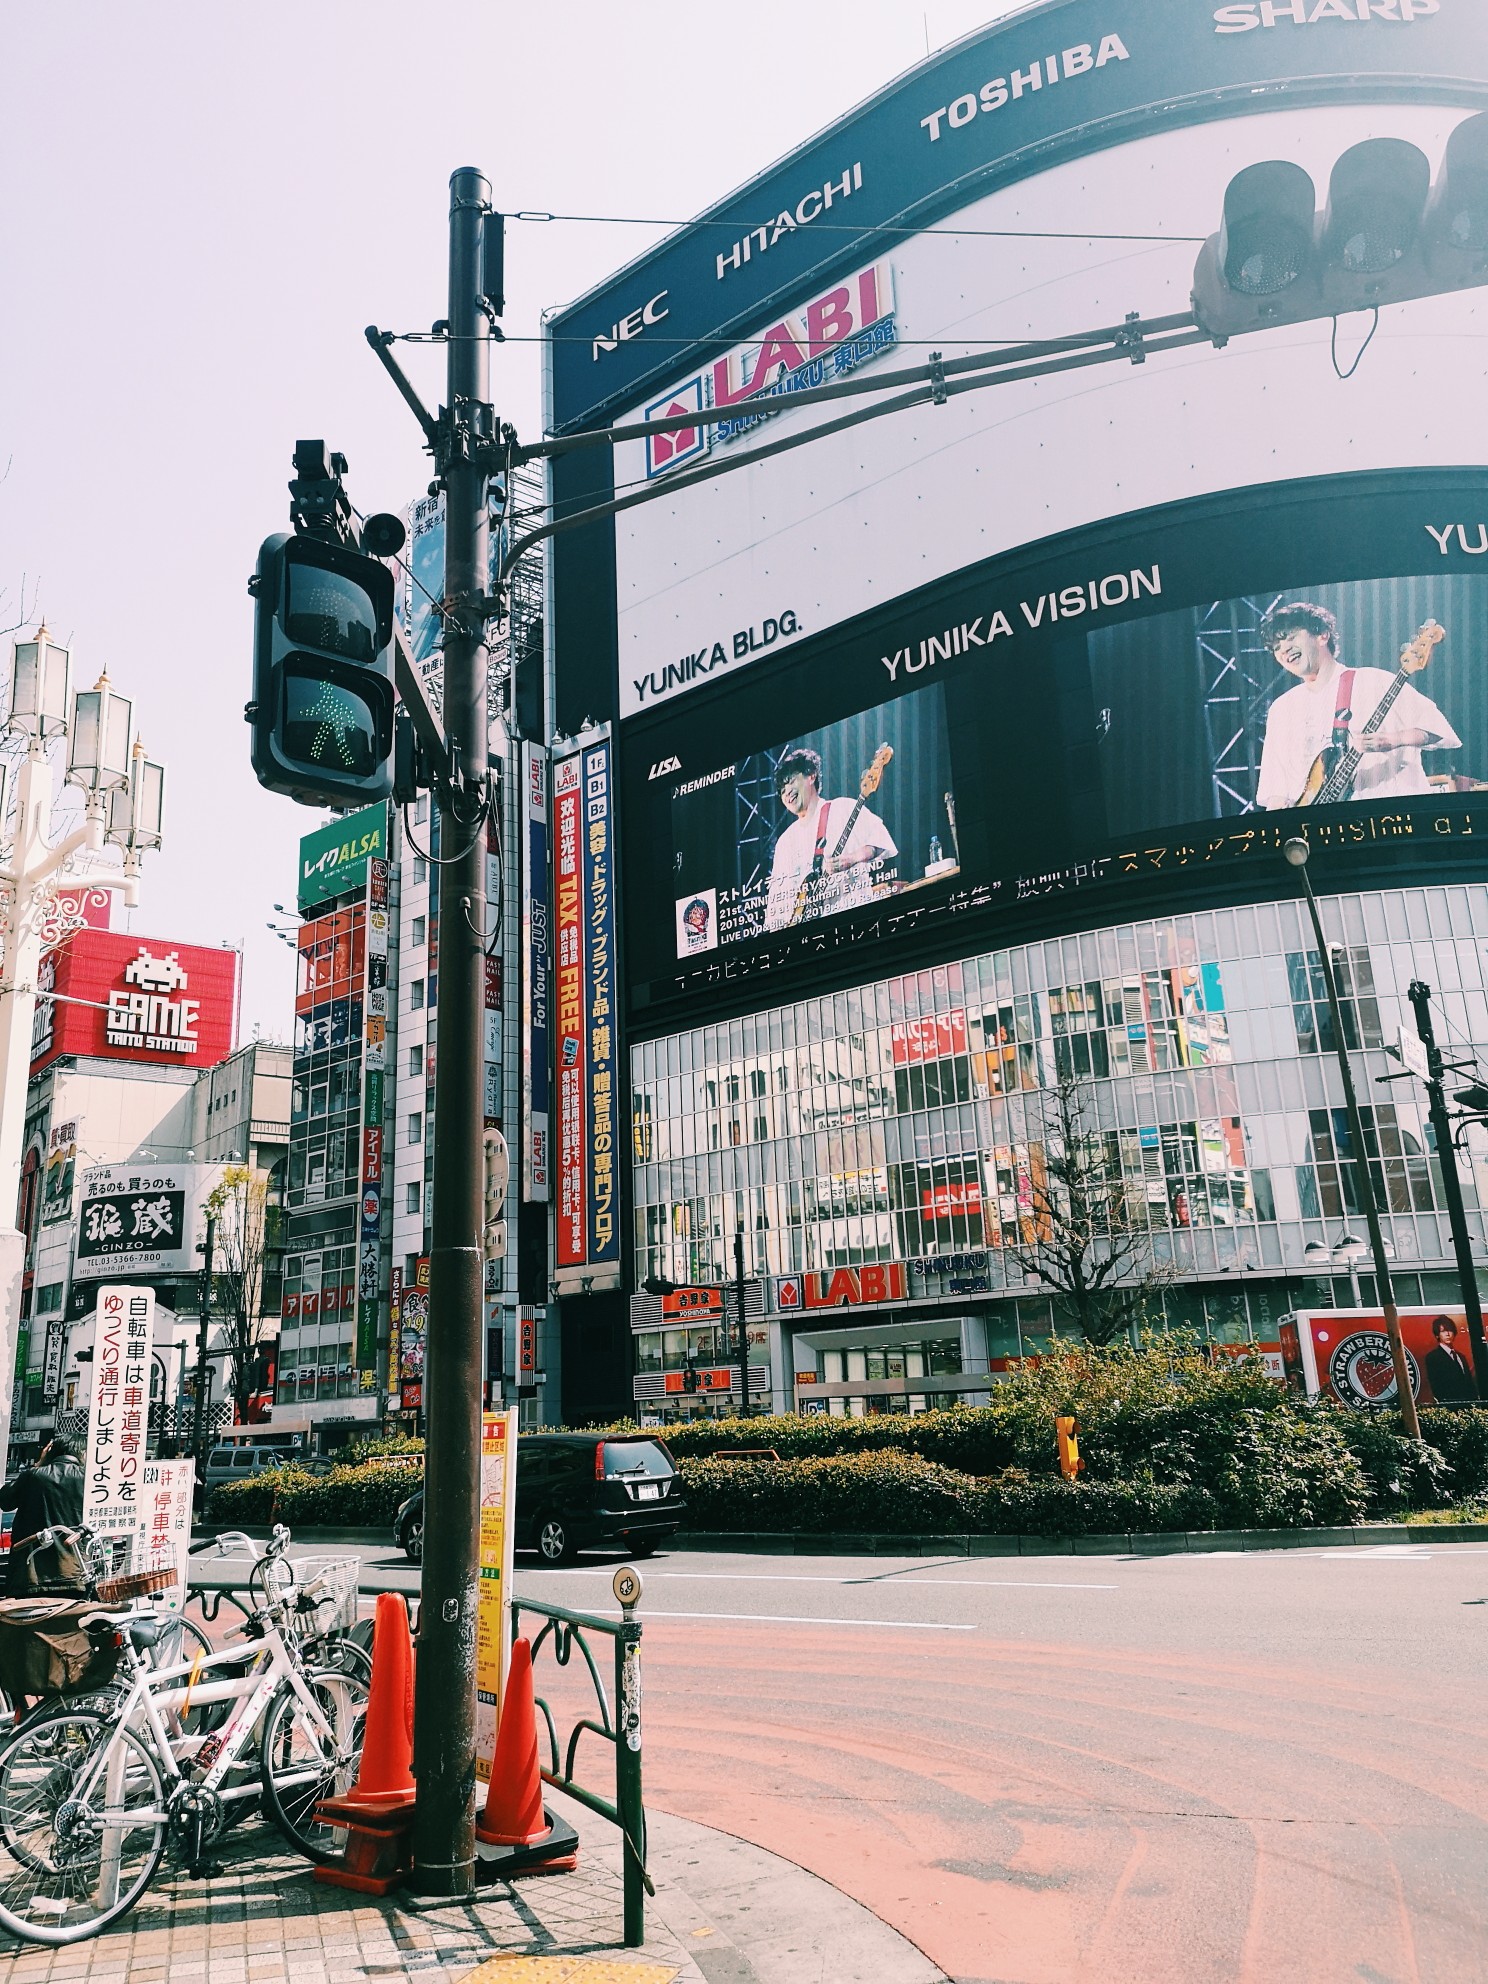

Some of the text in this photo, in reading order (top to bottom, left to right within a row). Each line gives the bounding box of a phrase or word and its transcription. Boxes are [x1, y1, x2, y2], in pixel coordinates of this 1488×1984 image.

[1213, 0, 1441, 33] SHARP
[920, 32, 1130, 142] TOSHIBA
[715, 161, 863, 280] HITACHI
[592, 289, 670, 361] NEC
[713, 265, 881, 408] LABI
[1424, 523, 1488, 554] YU
[881, 564, 1162, 682] YUNIKA VISION
[632, 609, 803, 702] YUNIKA BLDG.
[531, 758, 540, 791] LABI
[557, 773, 578, 789] LABI
[591, 781, 604, 793] B1
[680, 765, 736, 796] REMINDER
[590, 804, 605, 817] B2
[304, 829, 380, 879] レイクALSA
[559, 874, 578, 928] TAX
[719, 859, 885, 920] 21st ANNIVERSARY ROCK BAND
[719, 906, 776, 931] 2019.01.19
[791, 886, 840, 910] Makuhari
[842, 878, 874, 894] Event
[875, 868, 898, 883] Hall
[720, 931, 742, 945] LIVE
[858, 884, 899, 904] Release
[531, 898, 547, 1028] For Your JUST
[107, 989, 200, 1039] GAME
[560, 966, 580, 1035] FREE
[106, 1030, 198, 1054] TAITO STATION
[366, 1129, 379, 1179] アイフル
[534, 1131, 542, 1167] LABI
[83, 1169, 112, 1183] ブランド品
[88, 1177, 176, 1197] 売るのも 買うのも
[364, 1198, 378, 1215] 薬
[87, 1253, 161, 1267] TEL.03-5366-7800
[360, 1243, 378, 1300] 大勝軒
[914, 1252, 986, 1276] SHINJUKU
[287, 1289, 355, 1314] アイフル
[679, 1291, 710, 1307] 吉野家
[804, 1263, 901, 1309] LABI
[679, 1309, 711, 1317] YOSHINOYA
[522, 1324, 532, 1366] 吉野家
[90, 1294, 124, 1504] ゆっくり通行しましょう
[117, 1296, 148, 1502] 自転車は車道寄りを
